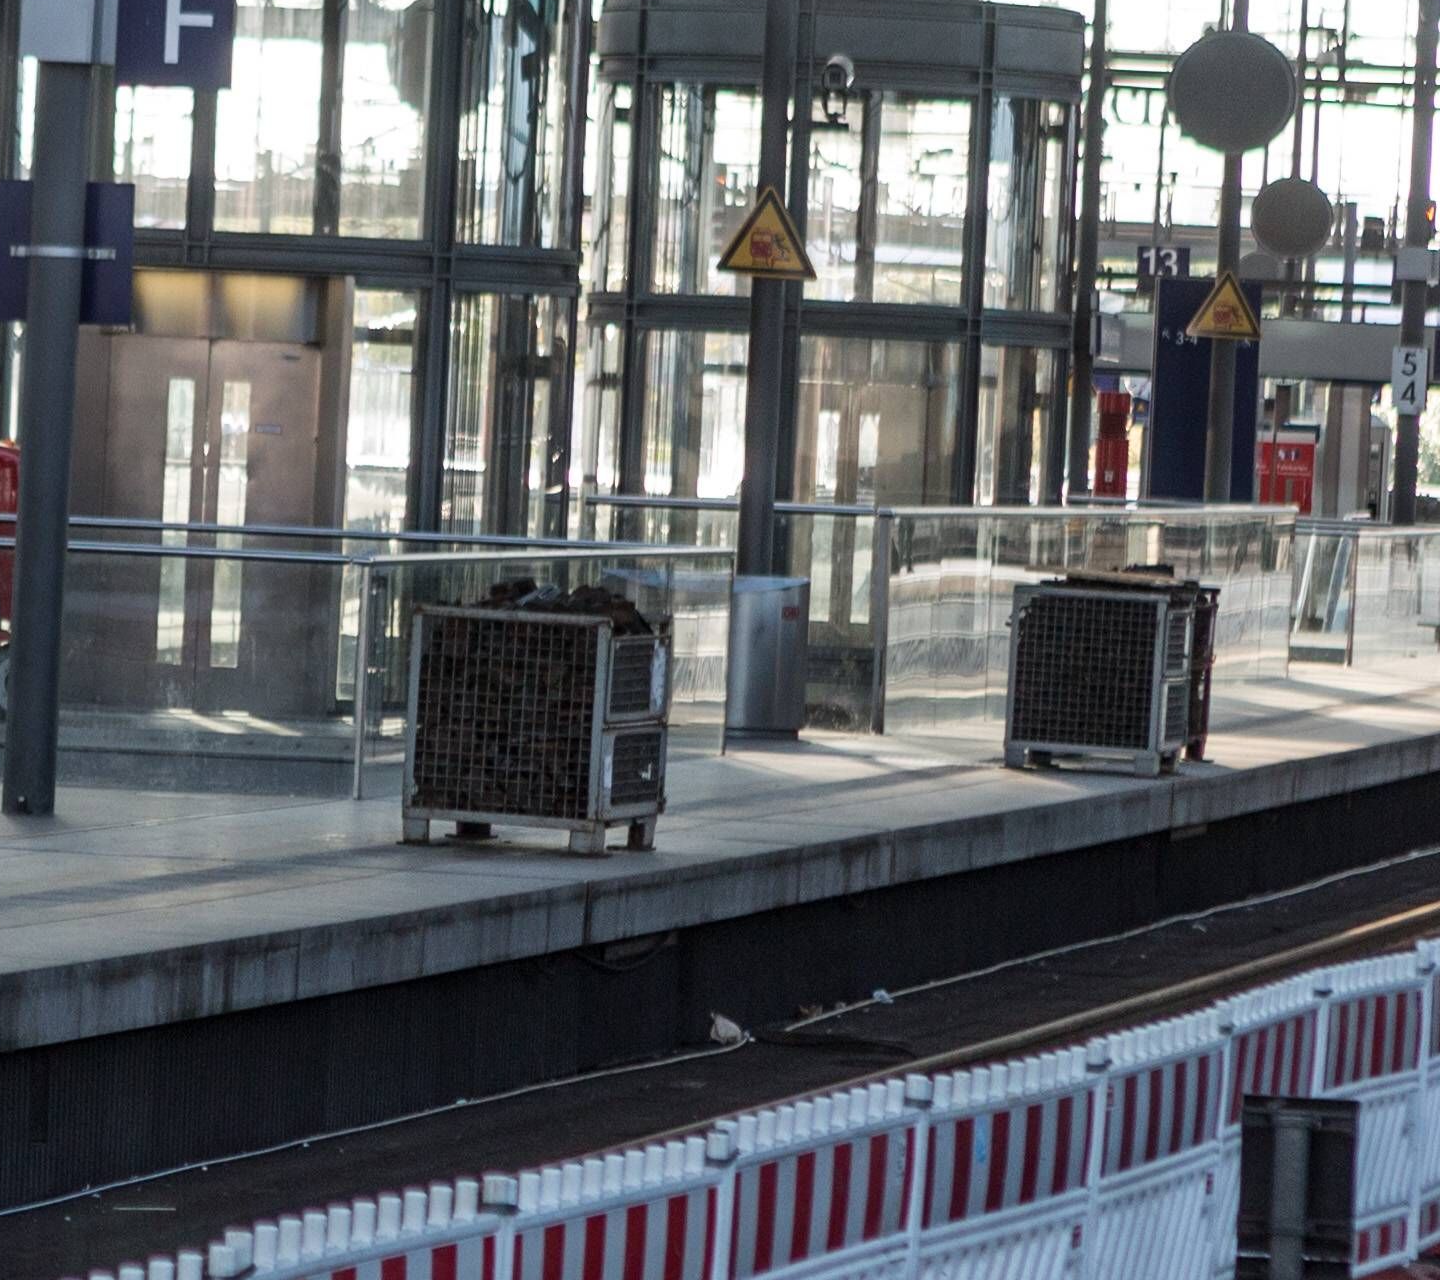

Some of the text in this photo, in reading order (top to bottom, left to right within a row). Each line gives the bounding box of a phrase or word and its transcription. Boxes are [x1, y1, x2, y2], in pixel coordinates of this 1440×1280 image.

[1142, 247, 1179, 277] 13
[1401, 351, 1417, 377] 5
[1400, 381, 1417, 406] 4
